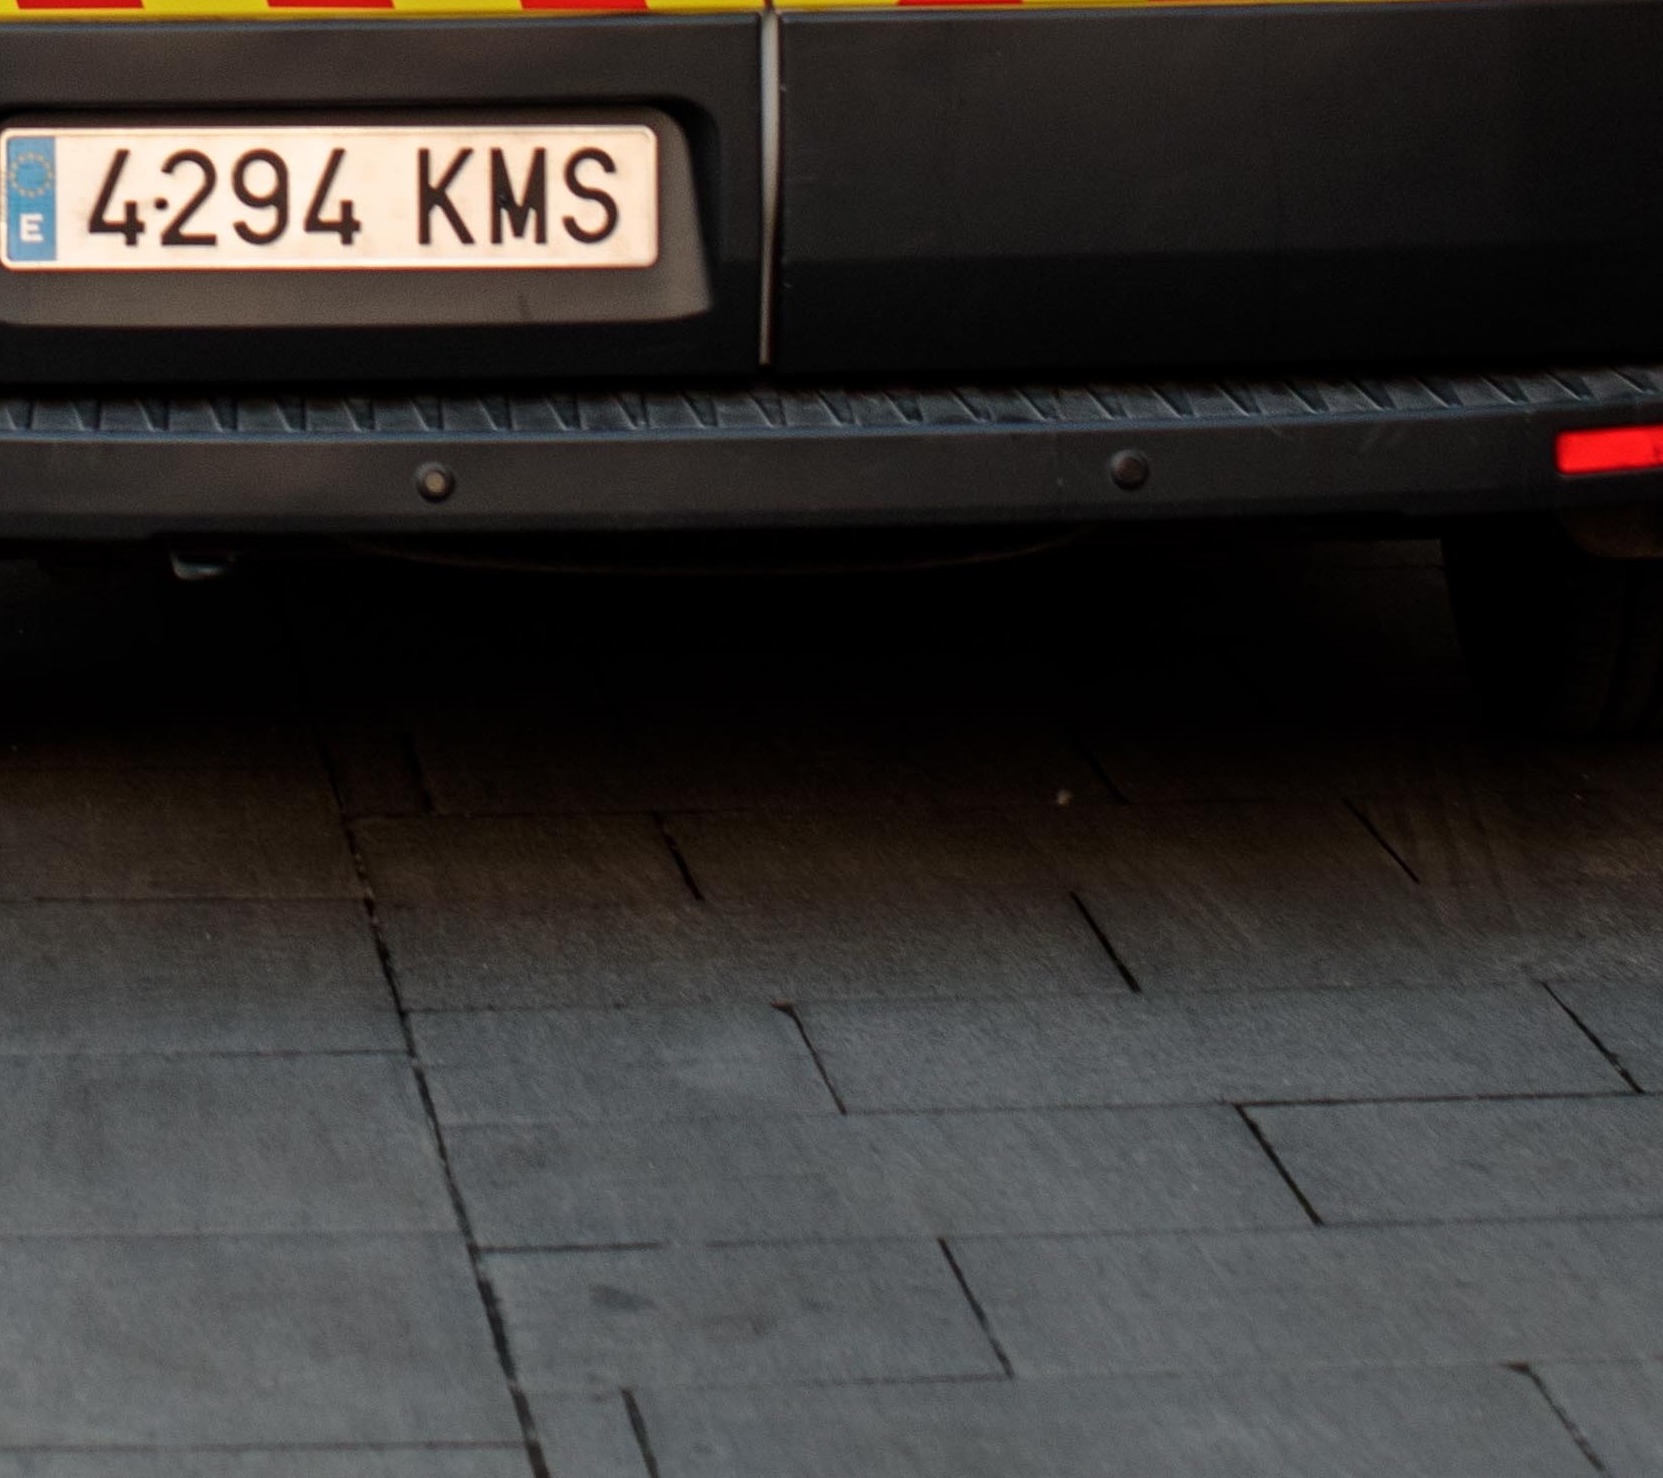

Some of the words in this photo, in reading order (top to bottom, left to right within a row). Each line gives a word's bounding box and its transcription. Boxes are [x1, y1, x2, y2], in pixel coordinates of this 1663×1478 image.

[19, 212, 44, 244] E
[87, 148, 362, 247] 4294
[418, 147, 620, 247] KMS
